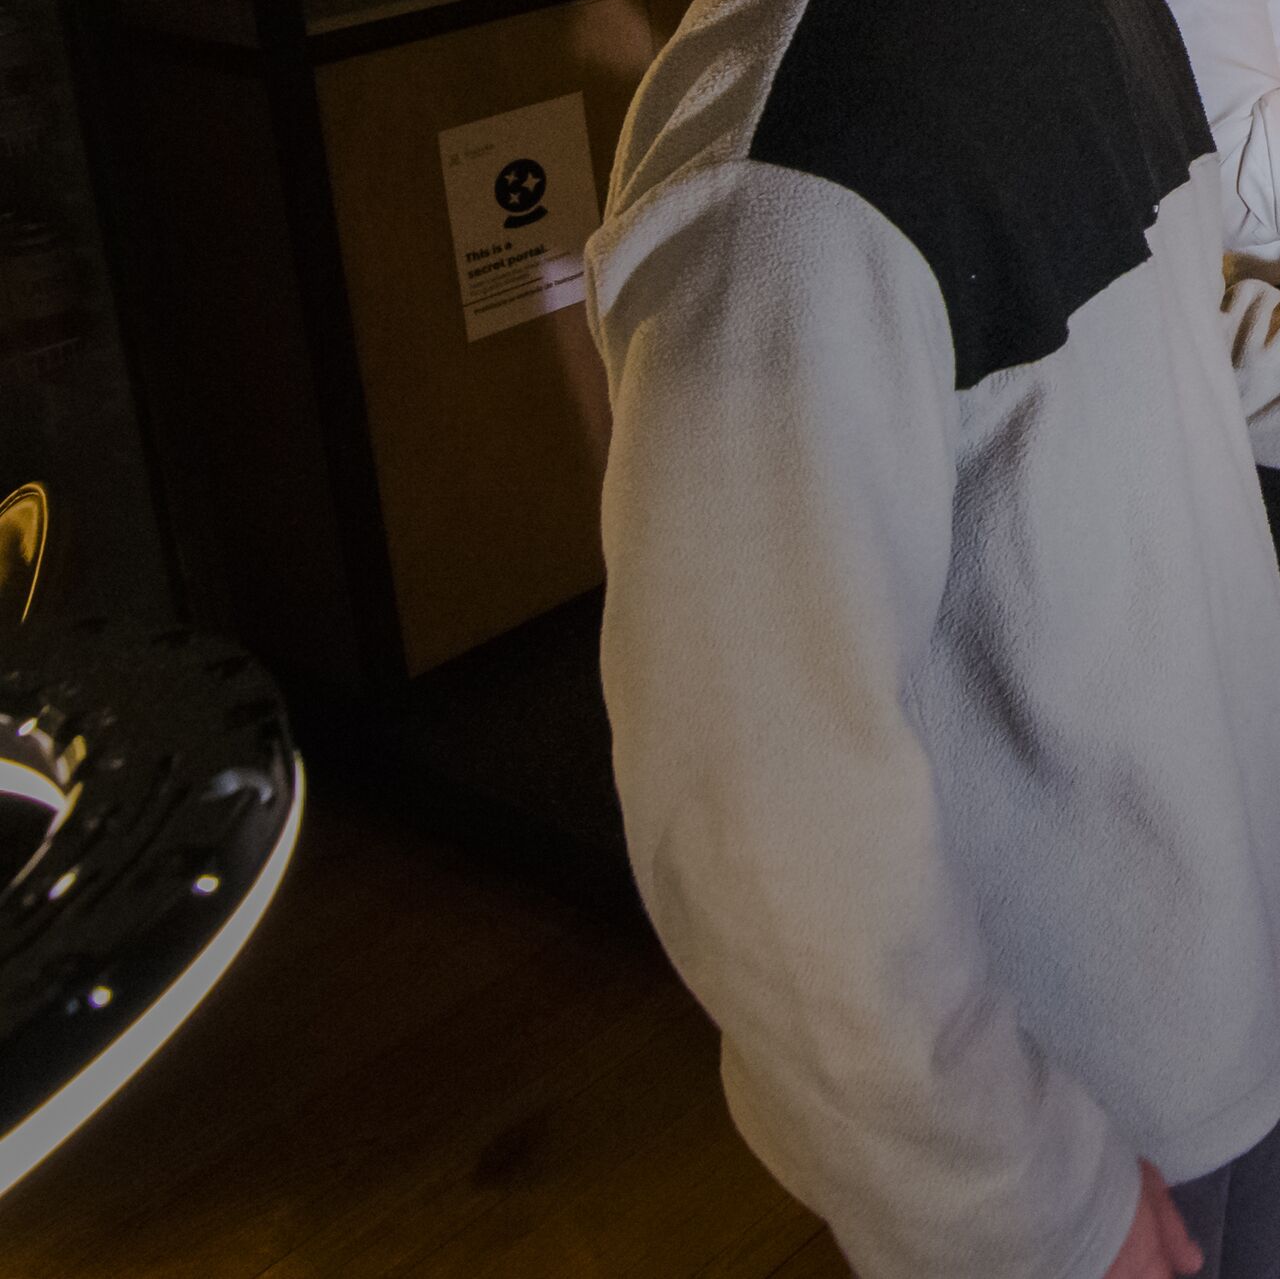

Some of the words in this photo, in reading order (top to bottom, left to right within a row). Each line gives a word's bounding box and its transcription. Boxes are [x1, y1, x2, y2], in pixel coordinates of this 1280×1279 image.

[465, 246, 490, 264] This
[491, 241, 504, 256] is
[504, 241, 513, 251] a
[467, 256, 506, 279] secret
